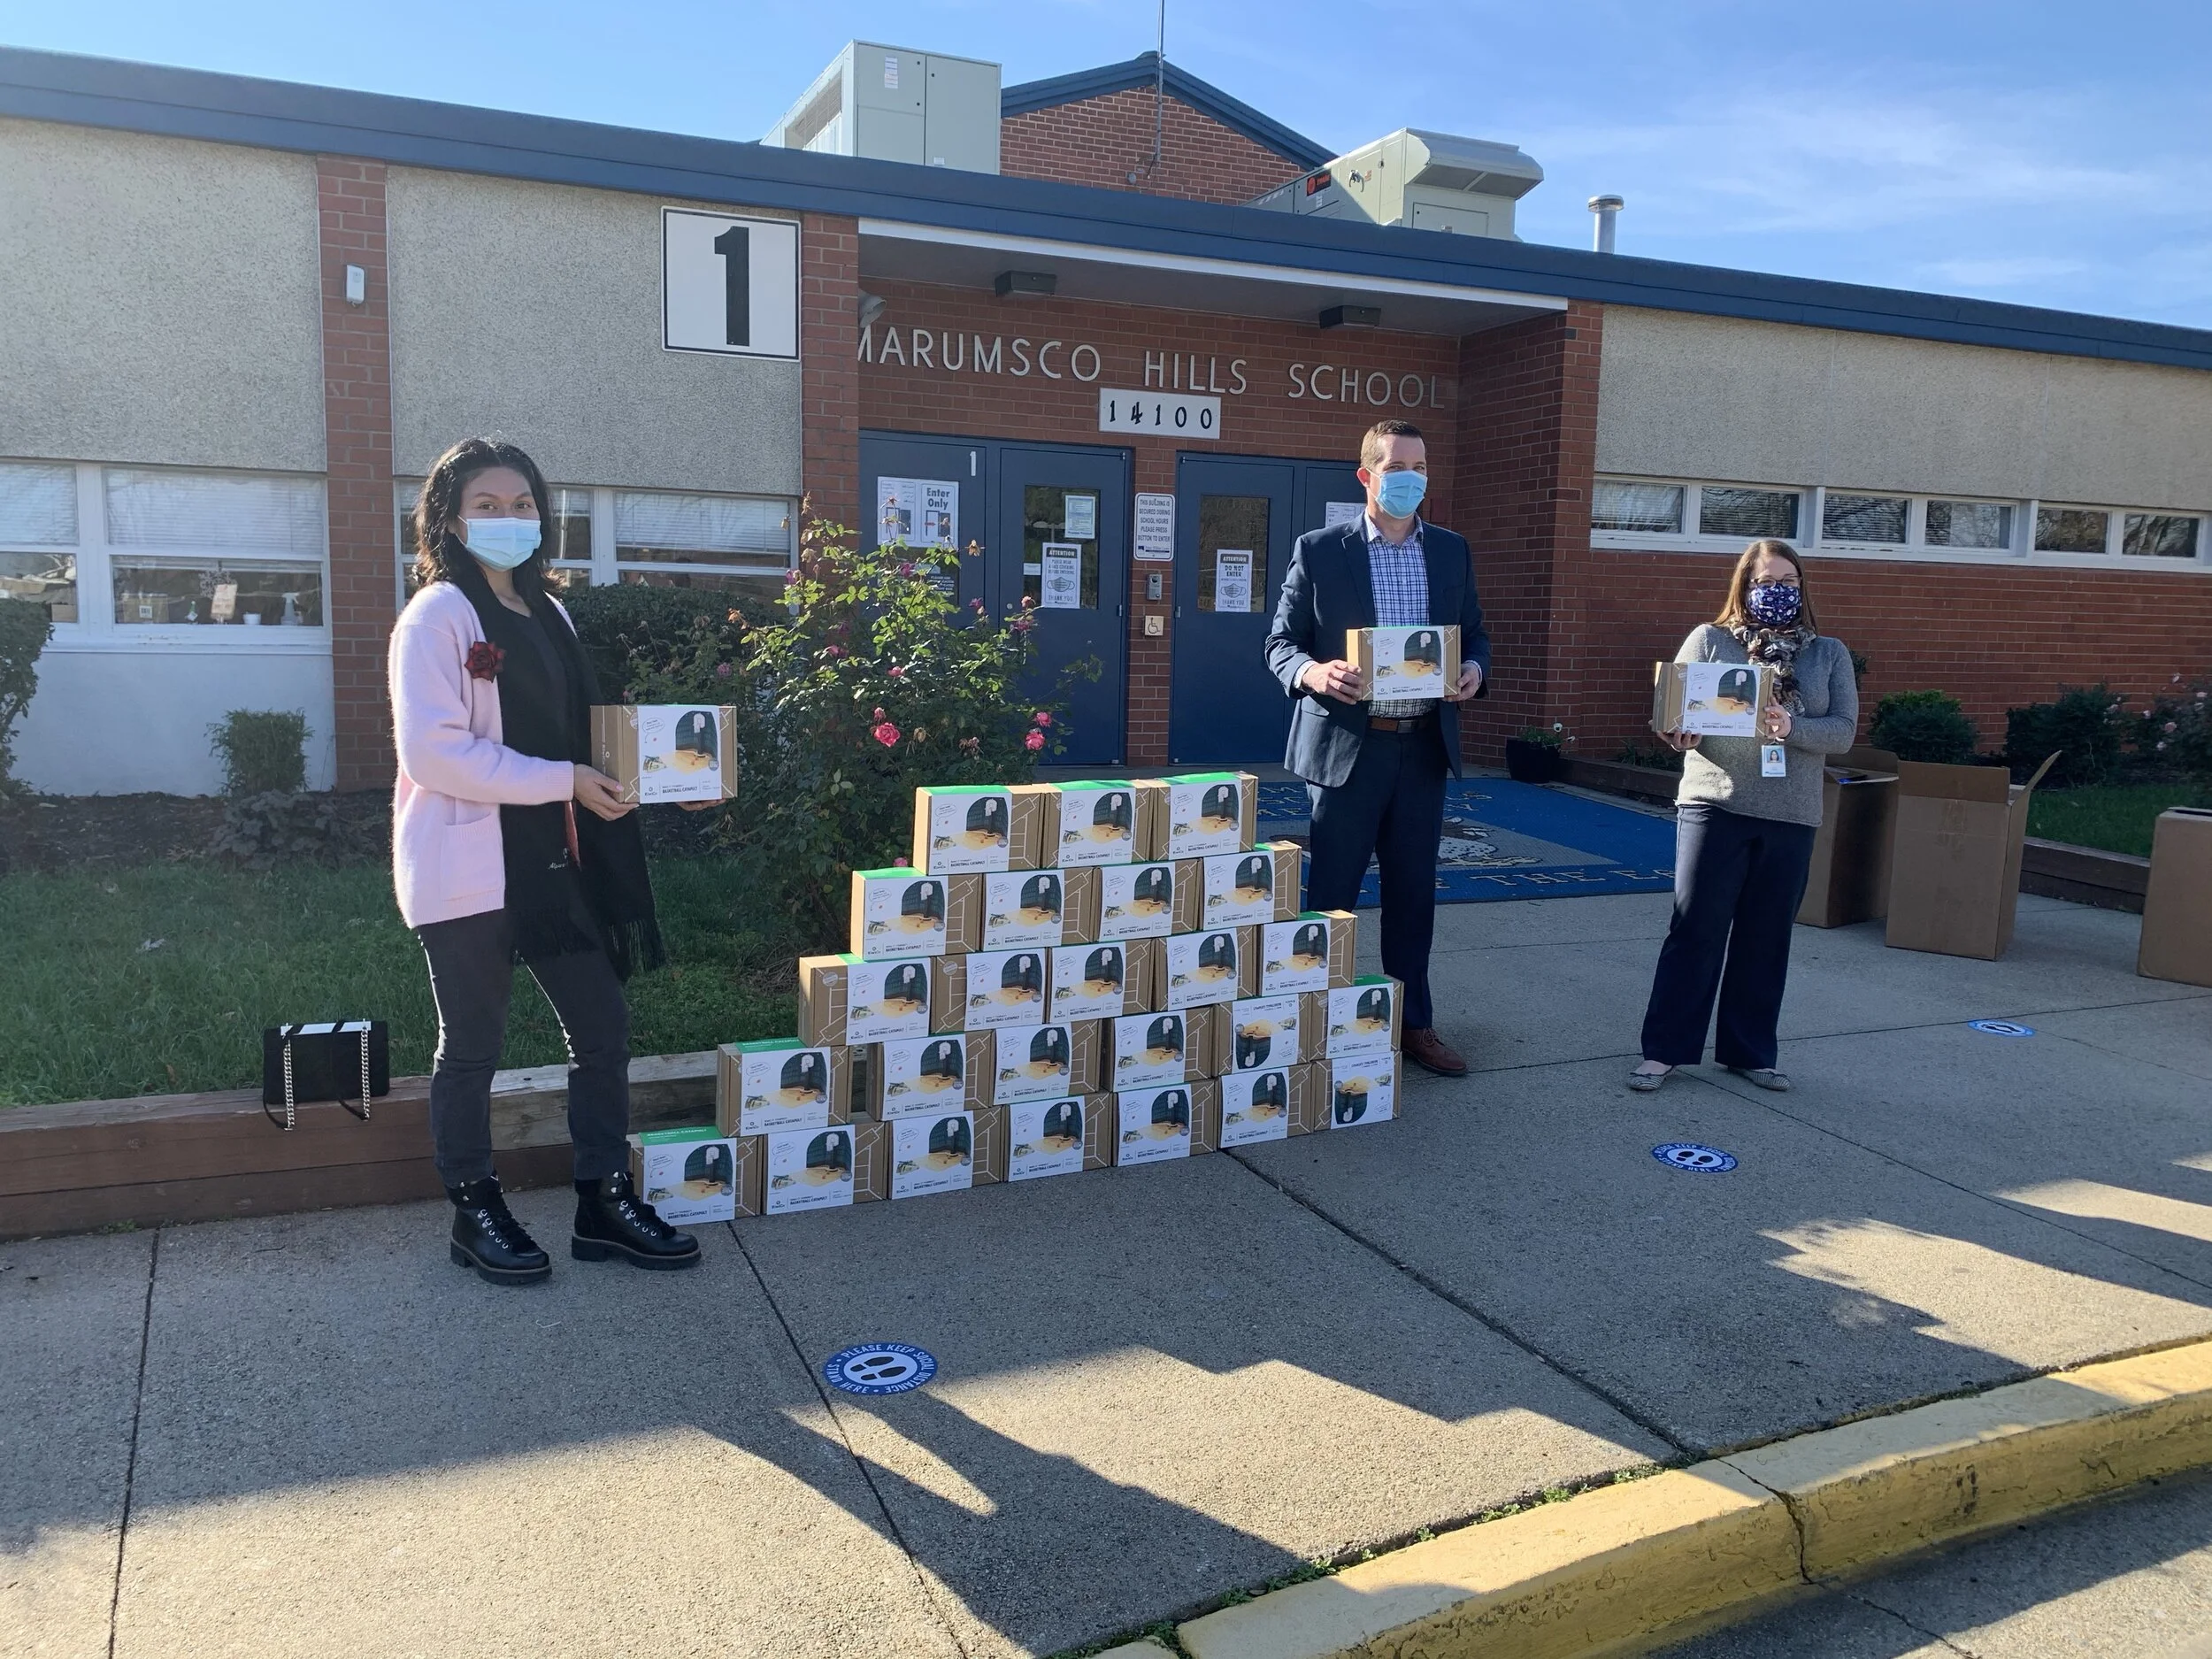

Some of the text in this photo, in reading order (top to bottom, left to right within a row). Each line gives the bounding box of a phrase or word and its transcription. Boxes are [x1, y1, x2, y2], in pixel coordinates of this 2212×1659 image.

[714, 226, 749, 348] 1
[1143, 349, 1248, 396] HILLS
[1287, 363, 1445, 409] SCHOOL
[1109, 399, 1213, 430] 14100
[970, 451, 976, 476] 1
[926, 488, 949, 497] Enter
[928, 498, 948, 510] Only
[826, 1364, 869, 1393] STAND HERE
[841, 1344, 935, 1393] PLEASE KEEP SOCIAL DISTANCE
